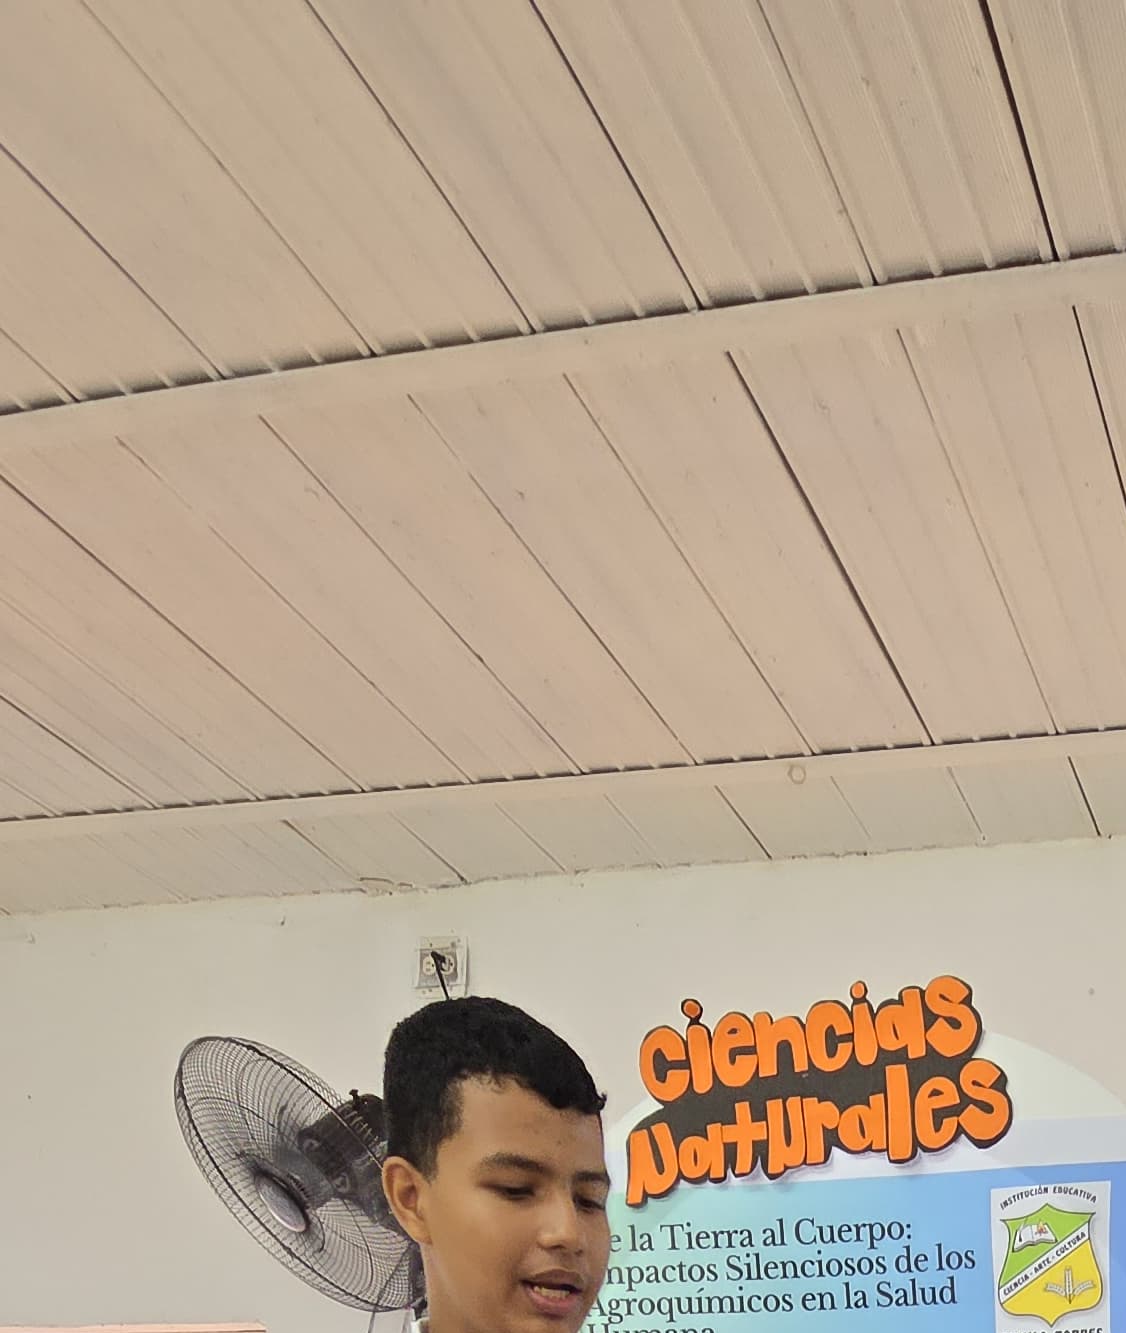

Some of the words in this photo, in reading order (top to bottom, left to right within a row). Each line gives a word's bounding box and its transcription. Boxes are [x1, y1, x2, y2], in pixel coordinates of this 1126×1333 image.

[1000, 1184, 1049, 1210] INSTITUCIÓN
[1052, 1185, 1097, 1204] EDUCATIVA
[628, 1224, 655, 1251] la
[660, 1222, 755, 1251] Tierra
[762, 1218, 787, 1247] al
[794, 1217, 912, 1250] Cuerpo:
[606, 1261, 718, 1292] mpactos
[726, 1249, 887, 1282] Silenciosos
[894, 1244, 929, 1274] de
[935, 1242, 976, 1271] los
[1003, 1272, 1030, 1297] CIENCIA
[1034, 1256, 1051, 1274] ARTE
[1056, 1231, 1086, 1257] CULTURA
[586, 1286, 794, 1325] Agroquímicos
[801, 1291, 838, 1312] en
[843, 1281, 869, 1310] la
[876, 1275, 958, 1308] Salud
